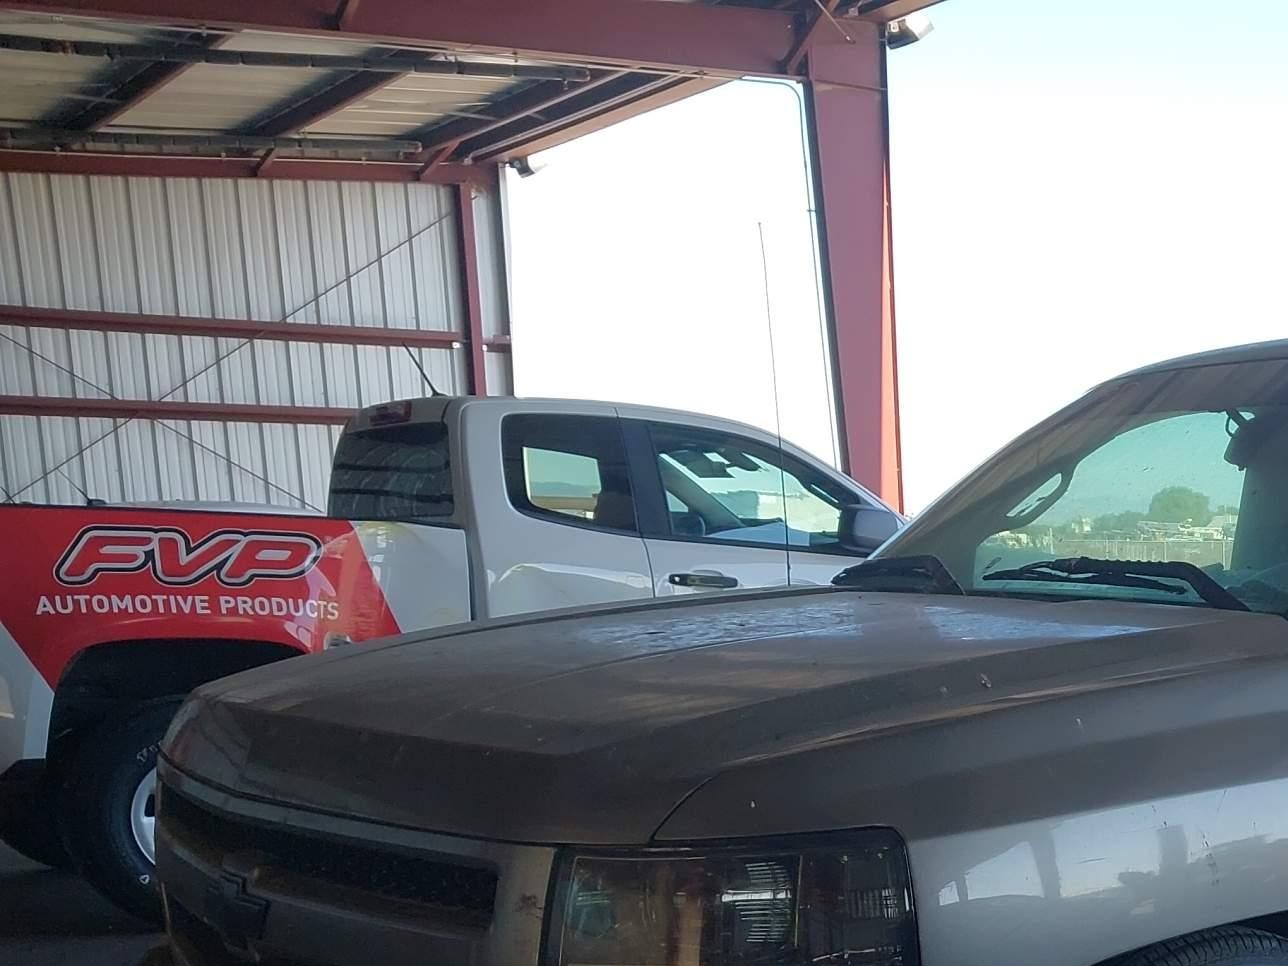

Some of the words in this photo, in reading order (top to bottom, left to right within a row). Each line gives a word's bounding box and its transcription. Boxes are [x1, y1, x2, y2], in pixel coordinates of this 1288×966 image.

[54, 525, 323, 588] FVP
[36, 594, 211, 615] AUTOMOTIVE
[220, 597, 339, 619] PRODUCTS
